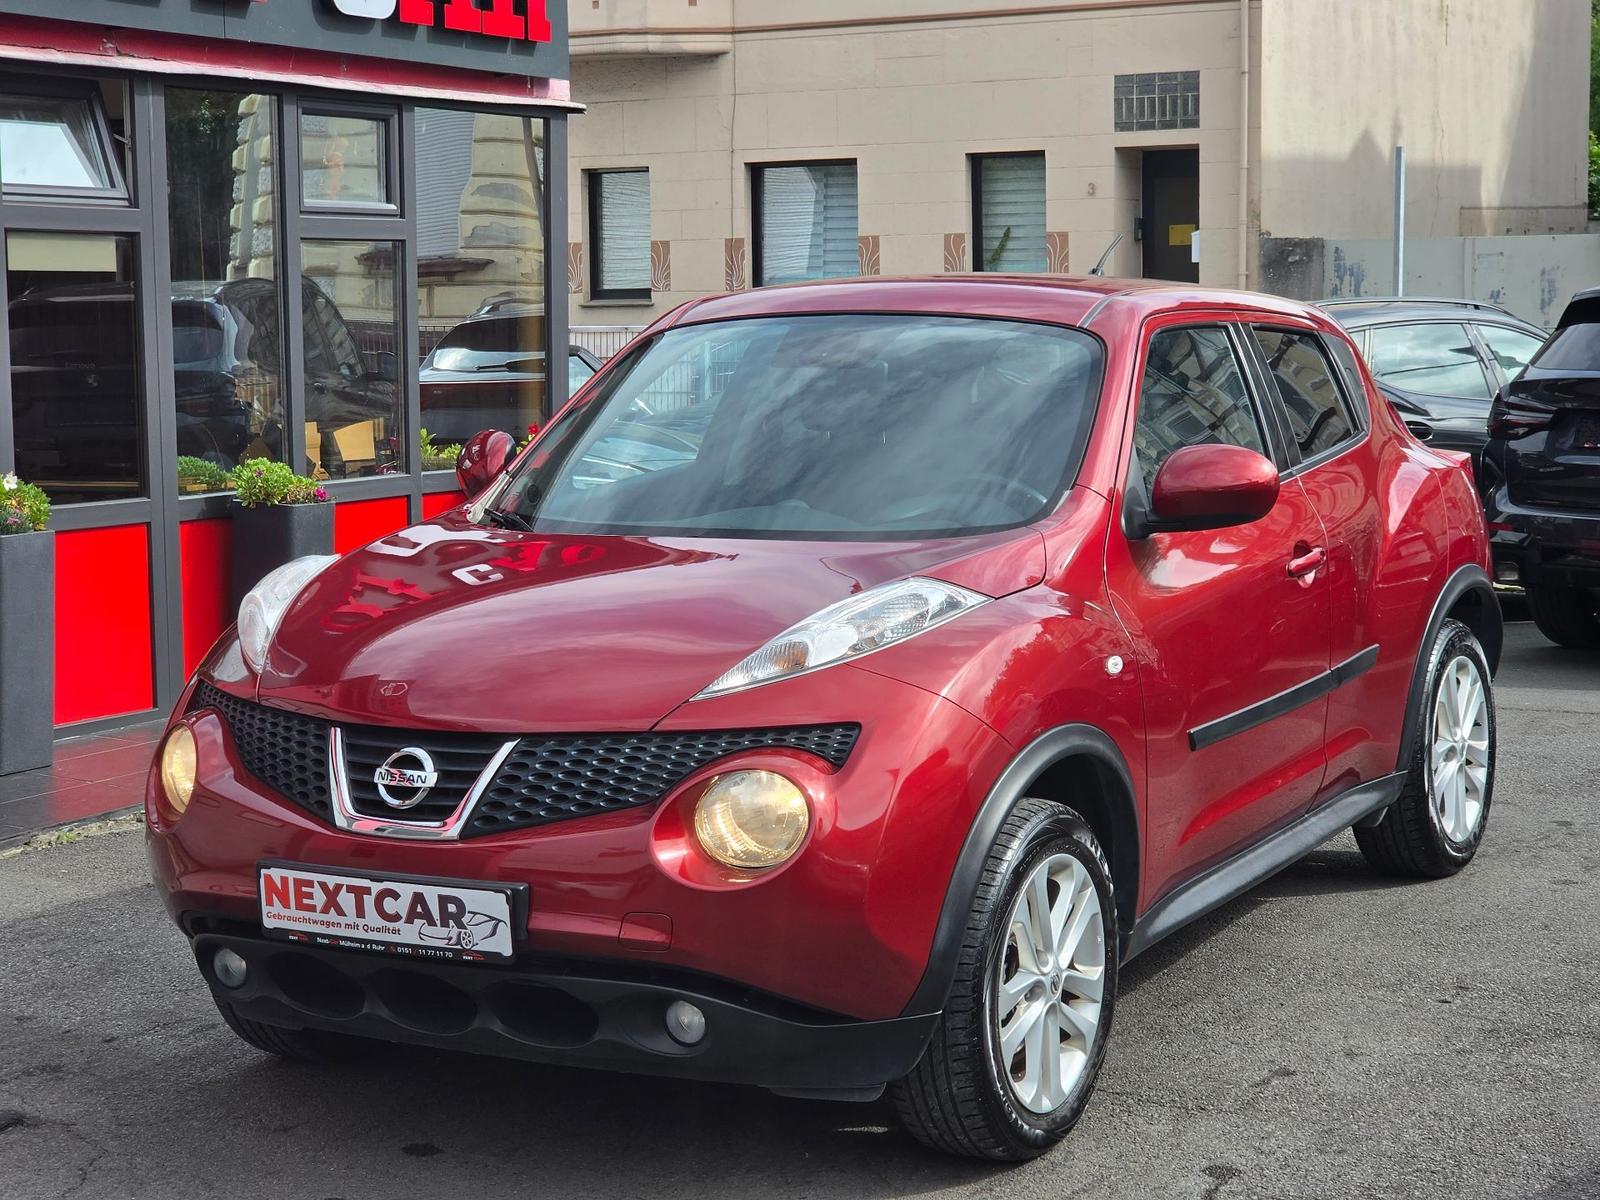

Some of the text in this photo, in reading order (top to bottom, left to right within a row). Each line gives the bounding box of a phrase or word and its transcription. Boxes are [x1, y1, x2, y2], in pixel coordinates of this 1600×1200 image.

[1087, 182, 1096, 197] 3
[377, 771, 427, 784] NISSAN
[263, 873, 469, 930] NEXTCAR
[266, 911, 401, 935] Gebrauchtwagen mit Qualität
[397, 946, 412, 955] 0151
